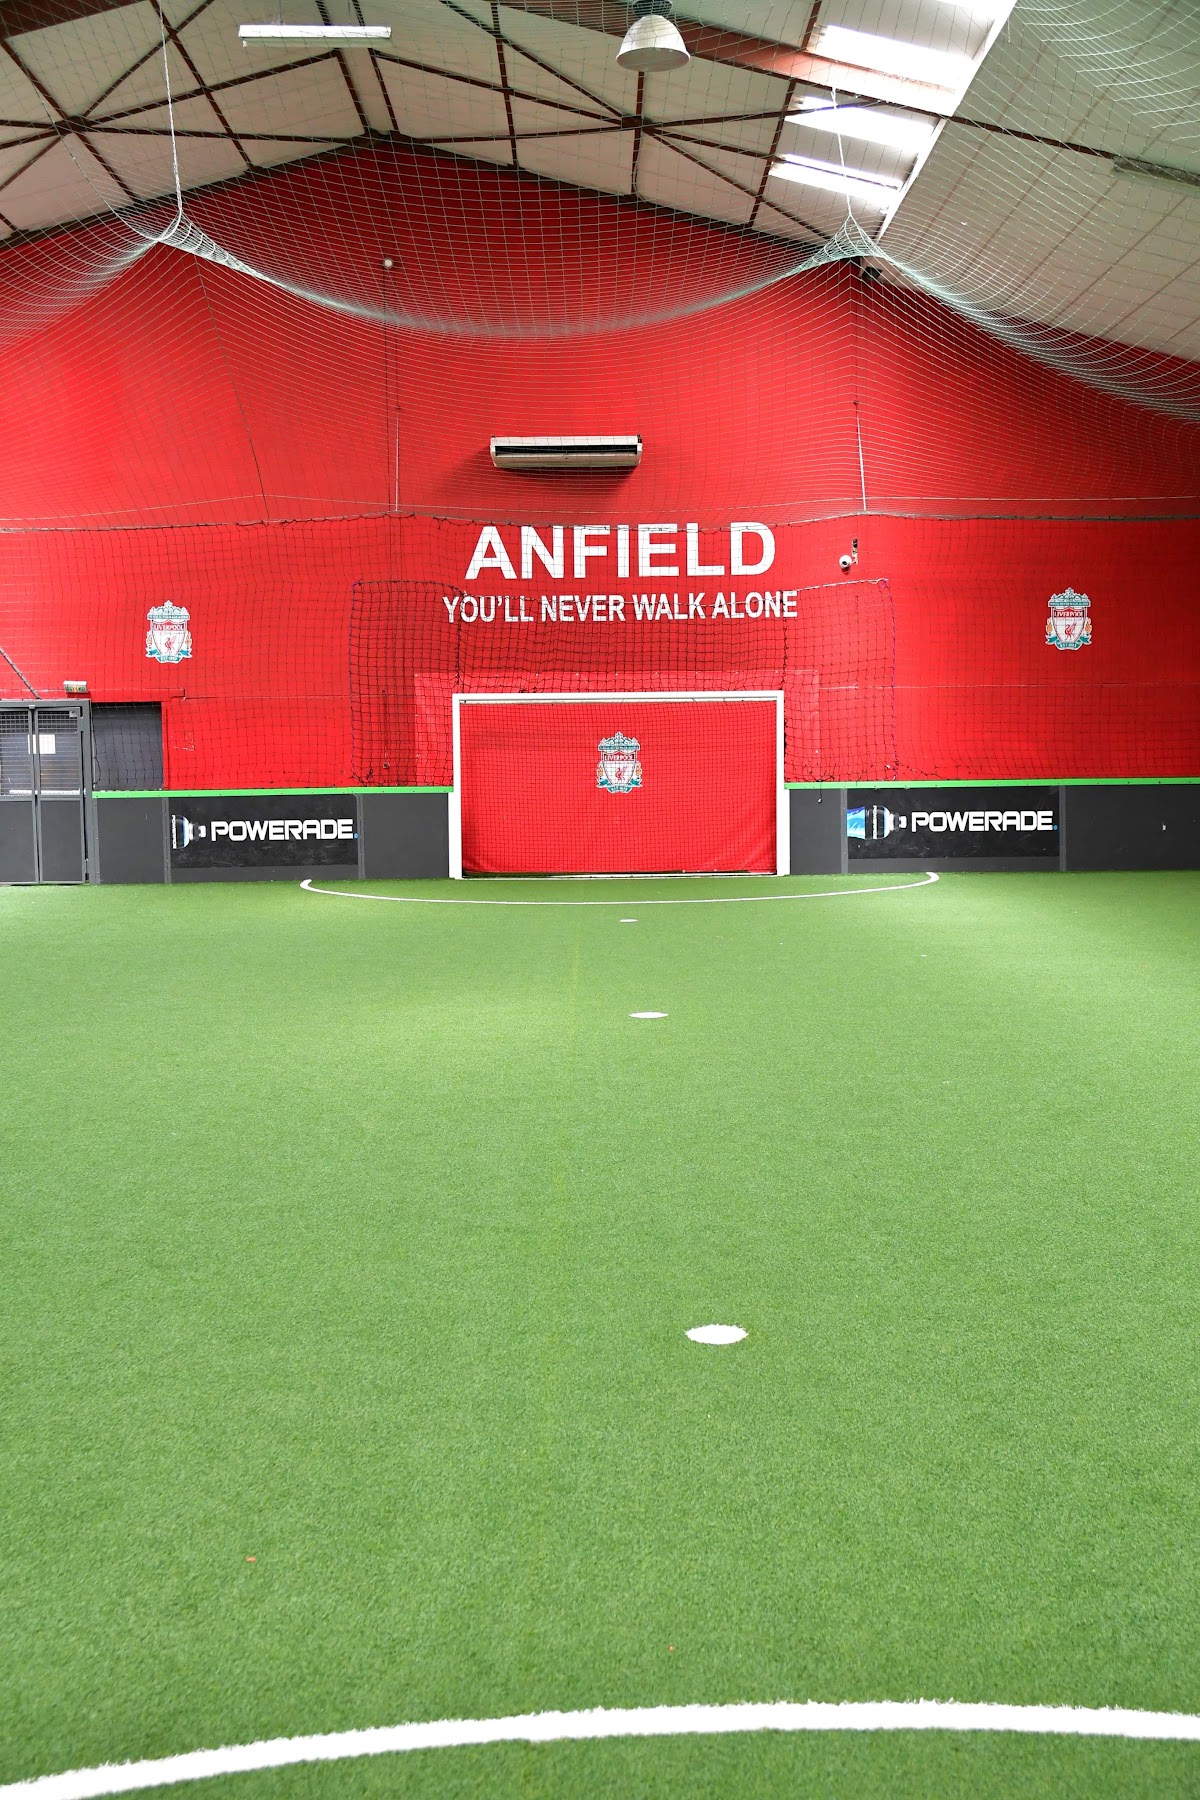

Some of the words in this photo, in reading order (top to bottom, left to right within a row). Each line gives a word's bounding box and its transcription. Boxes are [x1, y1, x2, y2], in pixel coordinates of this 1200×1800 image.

[464, 522, 777, 580] ANFIELD
[442, 594, 534, 623] YOU'LL
[541, 594, 626, 622] NEVER
[632, 592, 706, 621] WALK
[711, 590, 799, 619] ALONE
[210, 819, 354, 841] POWERADE
[911, 811, 1053, 832] POWERADE
